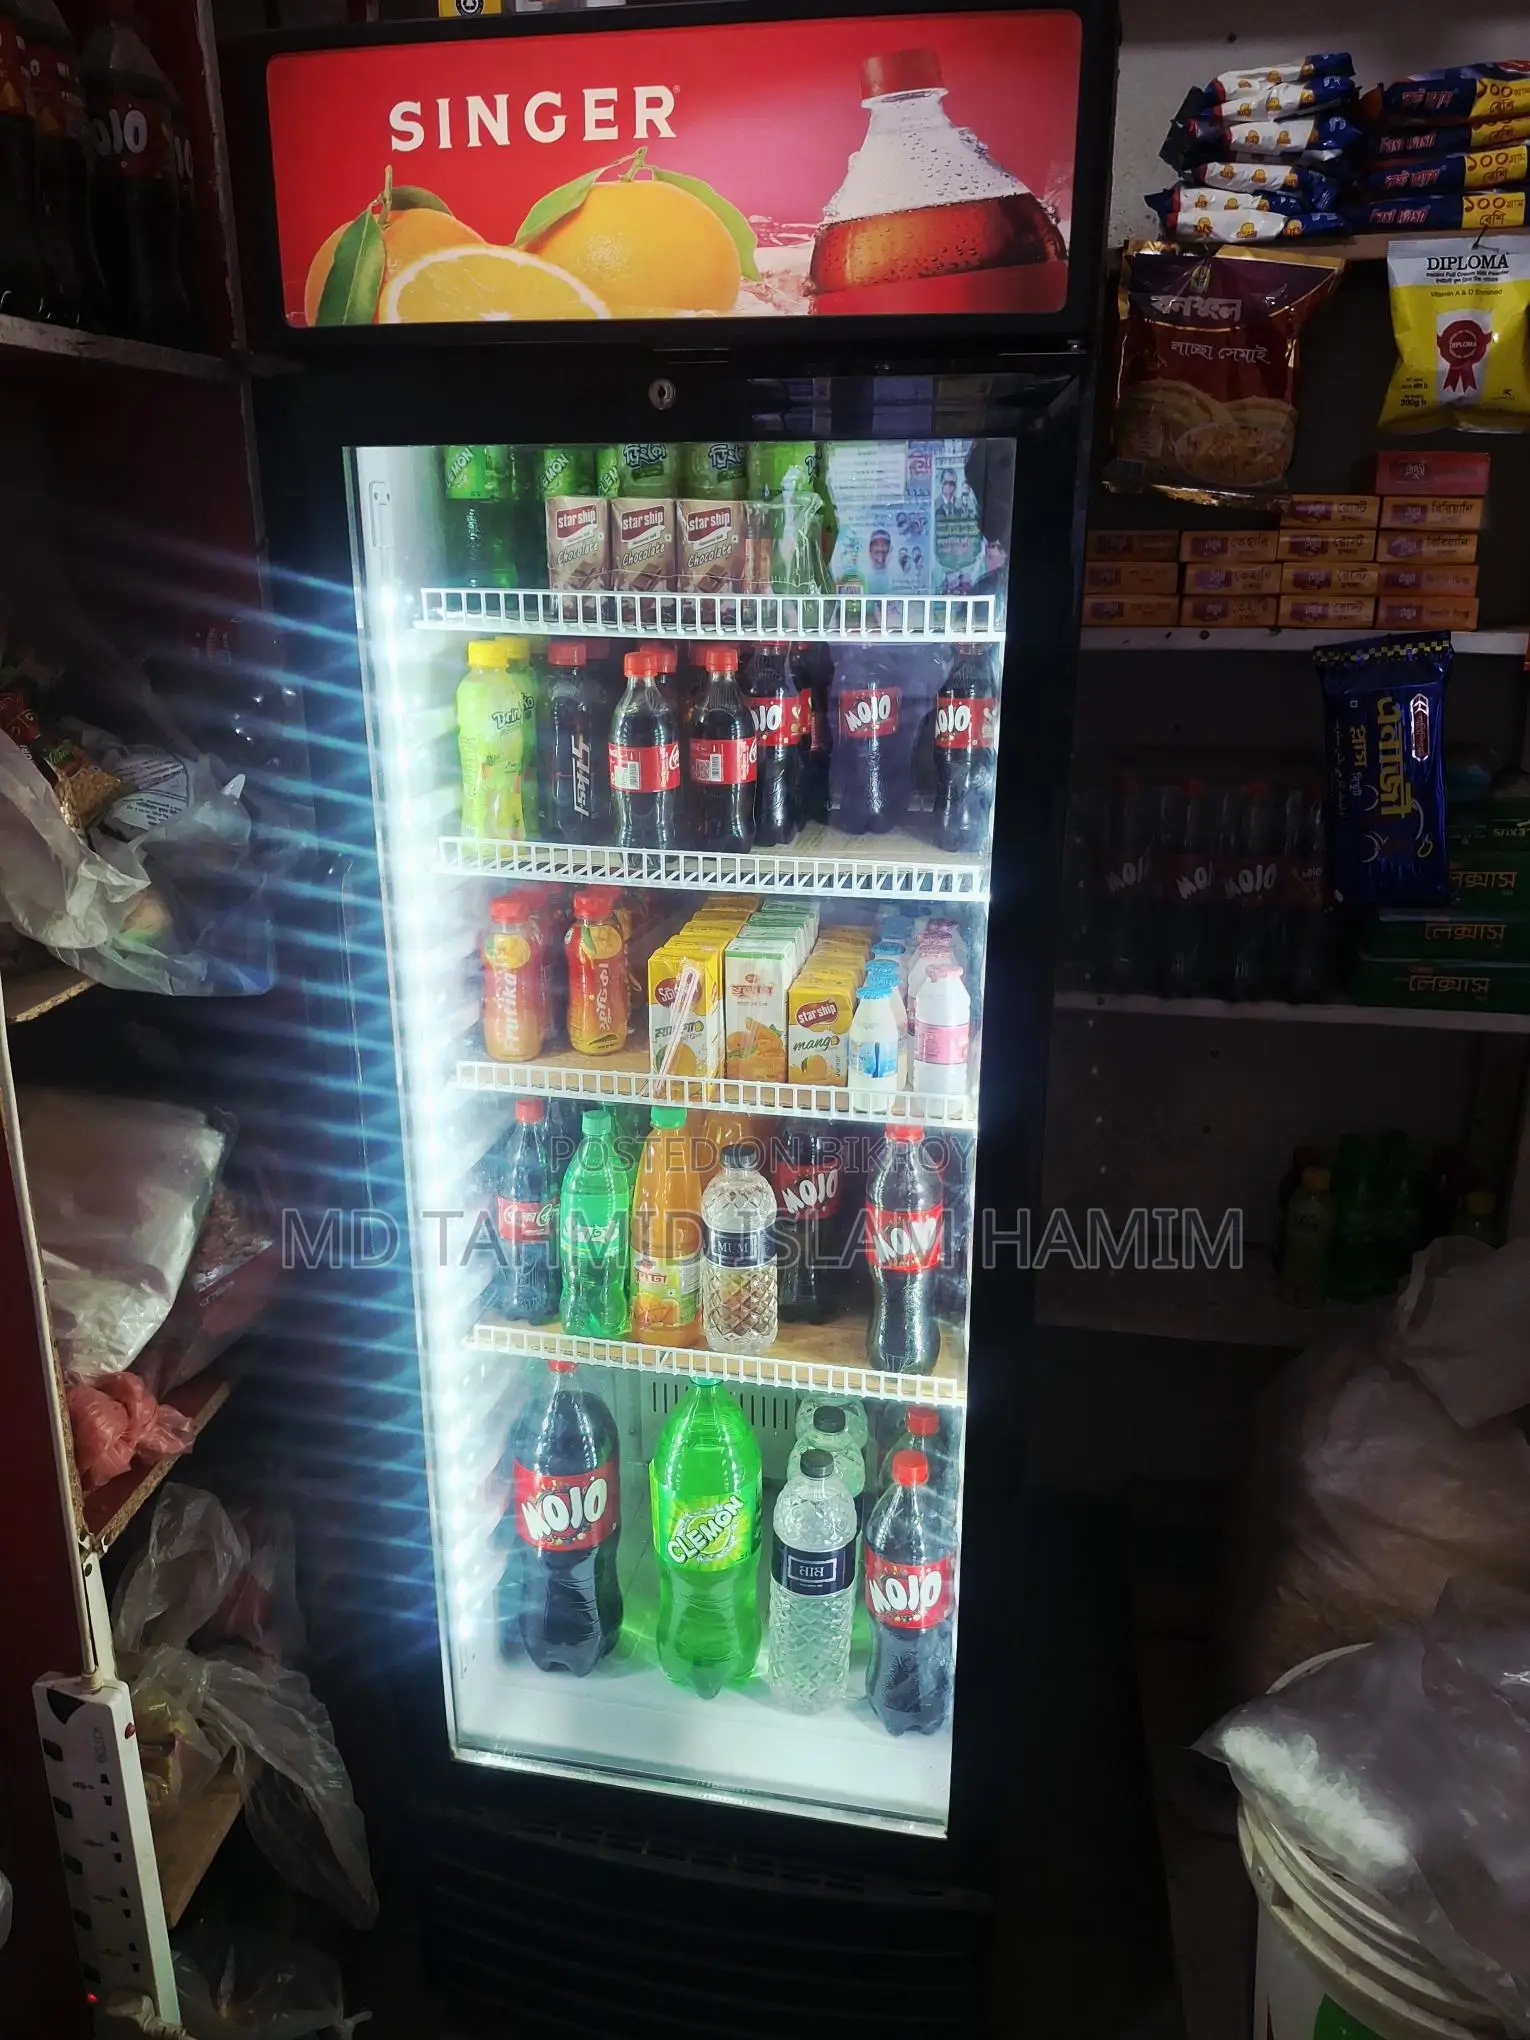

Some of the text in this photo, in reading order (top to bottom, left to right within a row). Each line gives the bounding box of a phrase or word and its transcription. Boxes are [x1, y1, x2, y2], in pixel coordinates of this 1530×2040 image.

[388, 85, 677, 152] SINGER
[1467, 152, 1509, 172] ১০০
[1464, 197, 1506, 213] ১০০
[1426, 254, 1509, 271] DIPLOMA
[1217, 344, 1272, 364] সেমাই
[557, 509, 597, 530] star ship
[622, 511, 664, 531] star ship
[689, 512, 731, 532] star ship
[557, 541, 599, 565] Chocolate
[622, 543, 666, 567] Chocolate
[687, 545, 733, 568] Chocolate
[845, 694, 891, 732] MOJO
[798, 1003, 837, 1025] star ship
[792, 1034, 840, 1052] mango
[781, 1169, 839, 1214] MOJO
[520, 1478, 608, 1541] MOJO
[667, 1494, 745, 1564] CLEMON
[868, 1571, 942, 1613] MOJO
